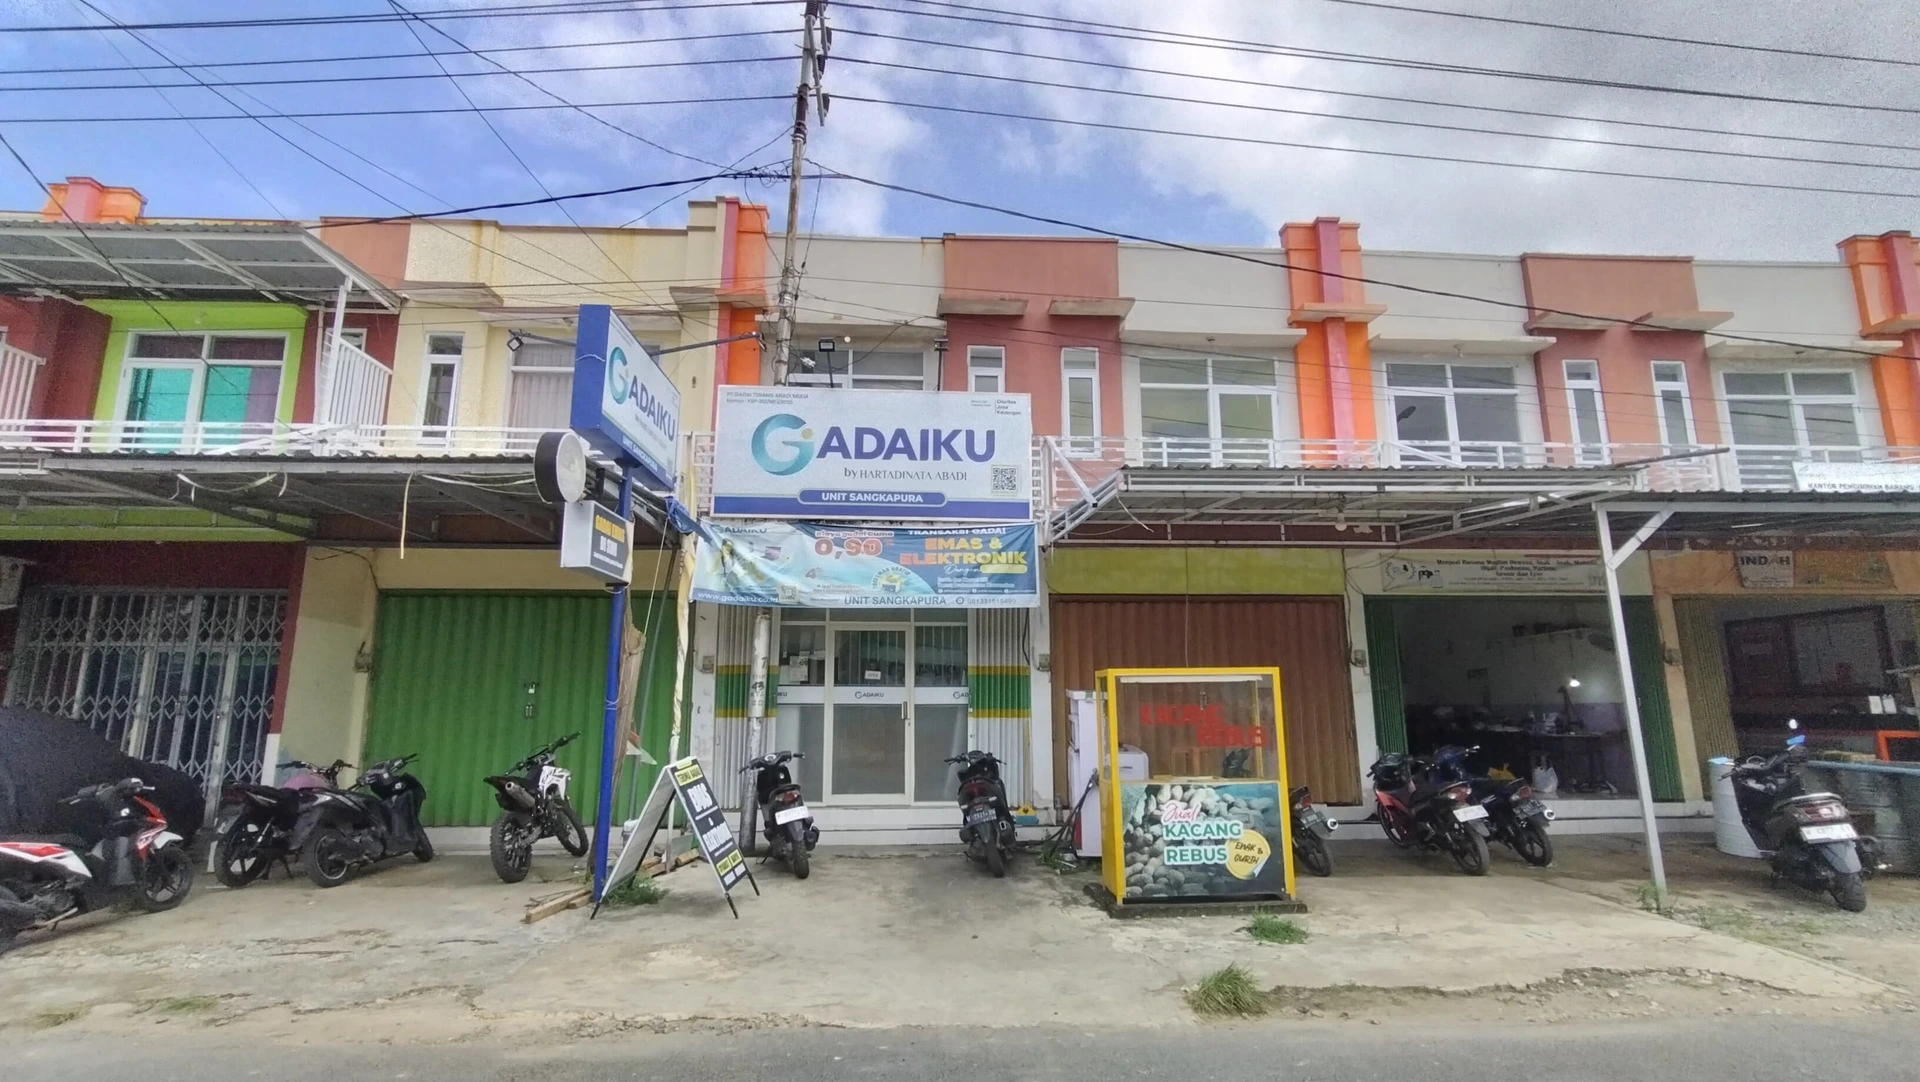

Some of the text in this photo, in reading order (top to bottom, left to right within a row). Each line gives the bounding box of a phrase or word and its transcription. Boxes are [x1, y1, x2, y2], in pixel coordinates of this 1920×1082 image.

[608, 346, 675, 442] GADAIKU
[751, 413, 996, 476] GADAIKU
[844, 467, 967, 481] by HARTADINATA ABADI
[821, 492, 924, 503] UNIT SANGKAPURA
[971, 527, 1006, 535] GADAI
[925, 537, 1003, 550] EMAS &
[899, 551, 1028, 565] ELEKTRONIK
[1740, 556, 1790, 566] INDAH
[844, 596, 869, 605] UNIT
[872, 596, 947, 606] SANGKAPURA
[854, 691, 885, 699] GADAIKU
[1163, 802, 1201, 822] Jual
[1164, 822, 1242, 837] KACANG
[1166, 848, 1228, 862] REBUS
[1234, 854, 1260, 865] GURIH
